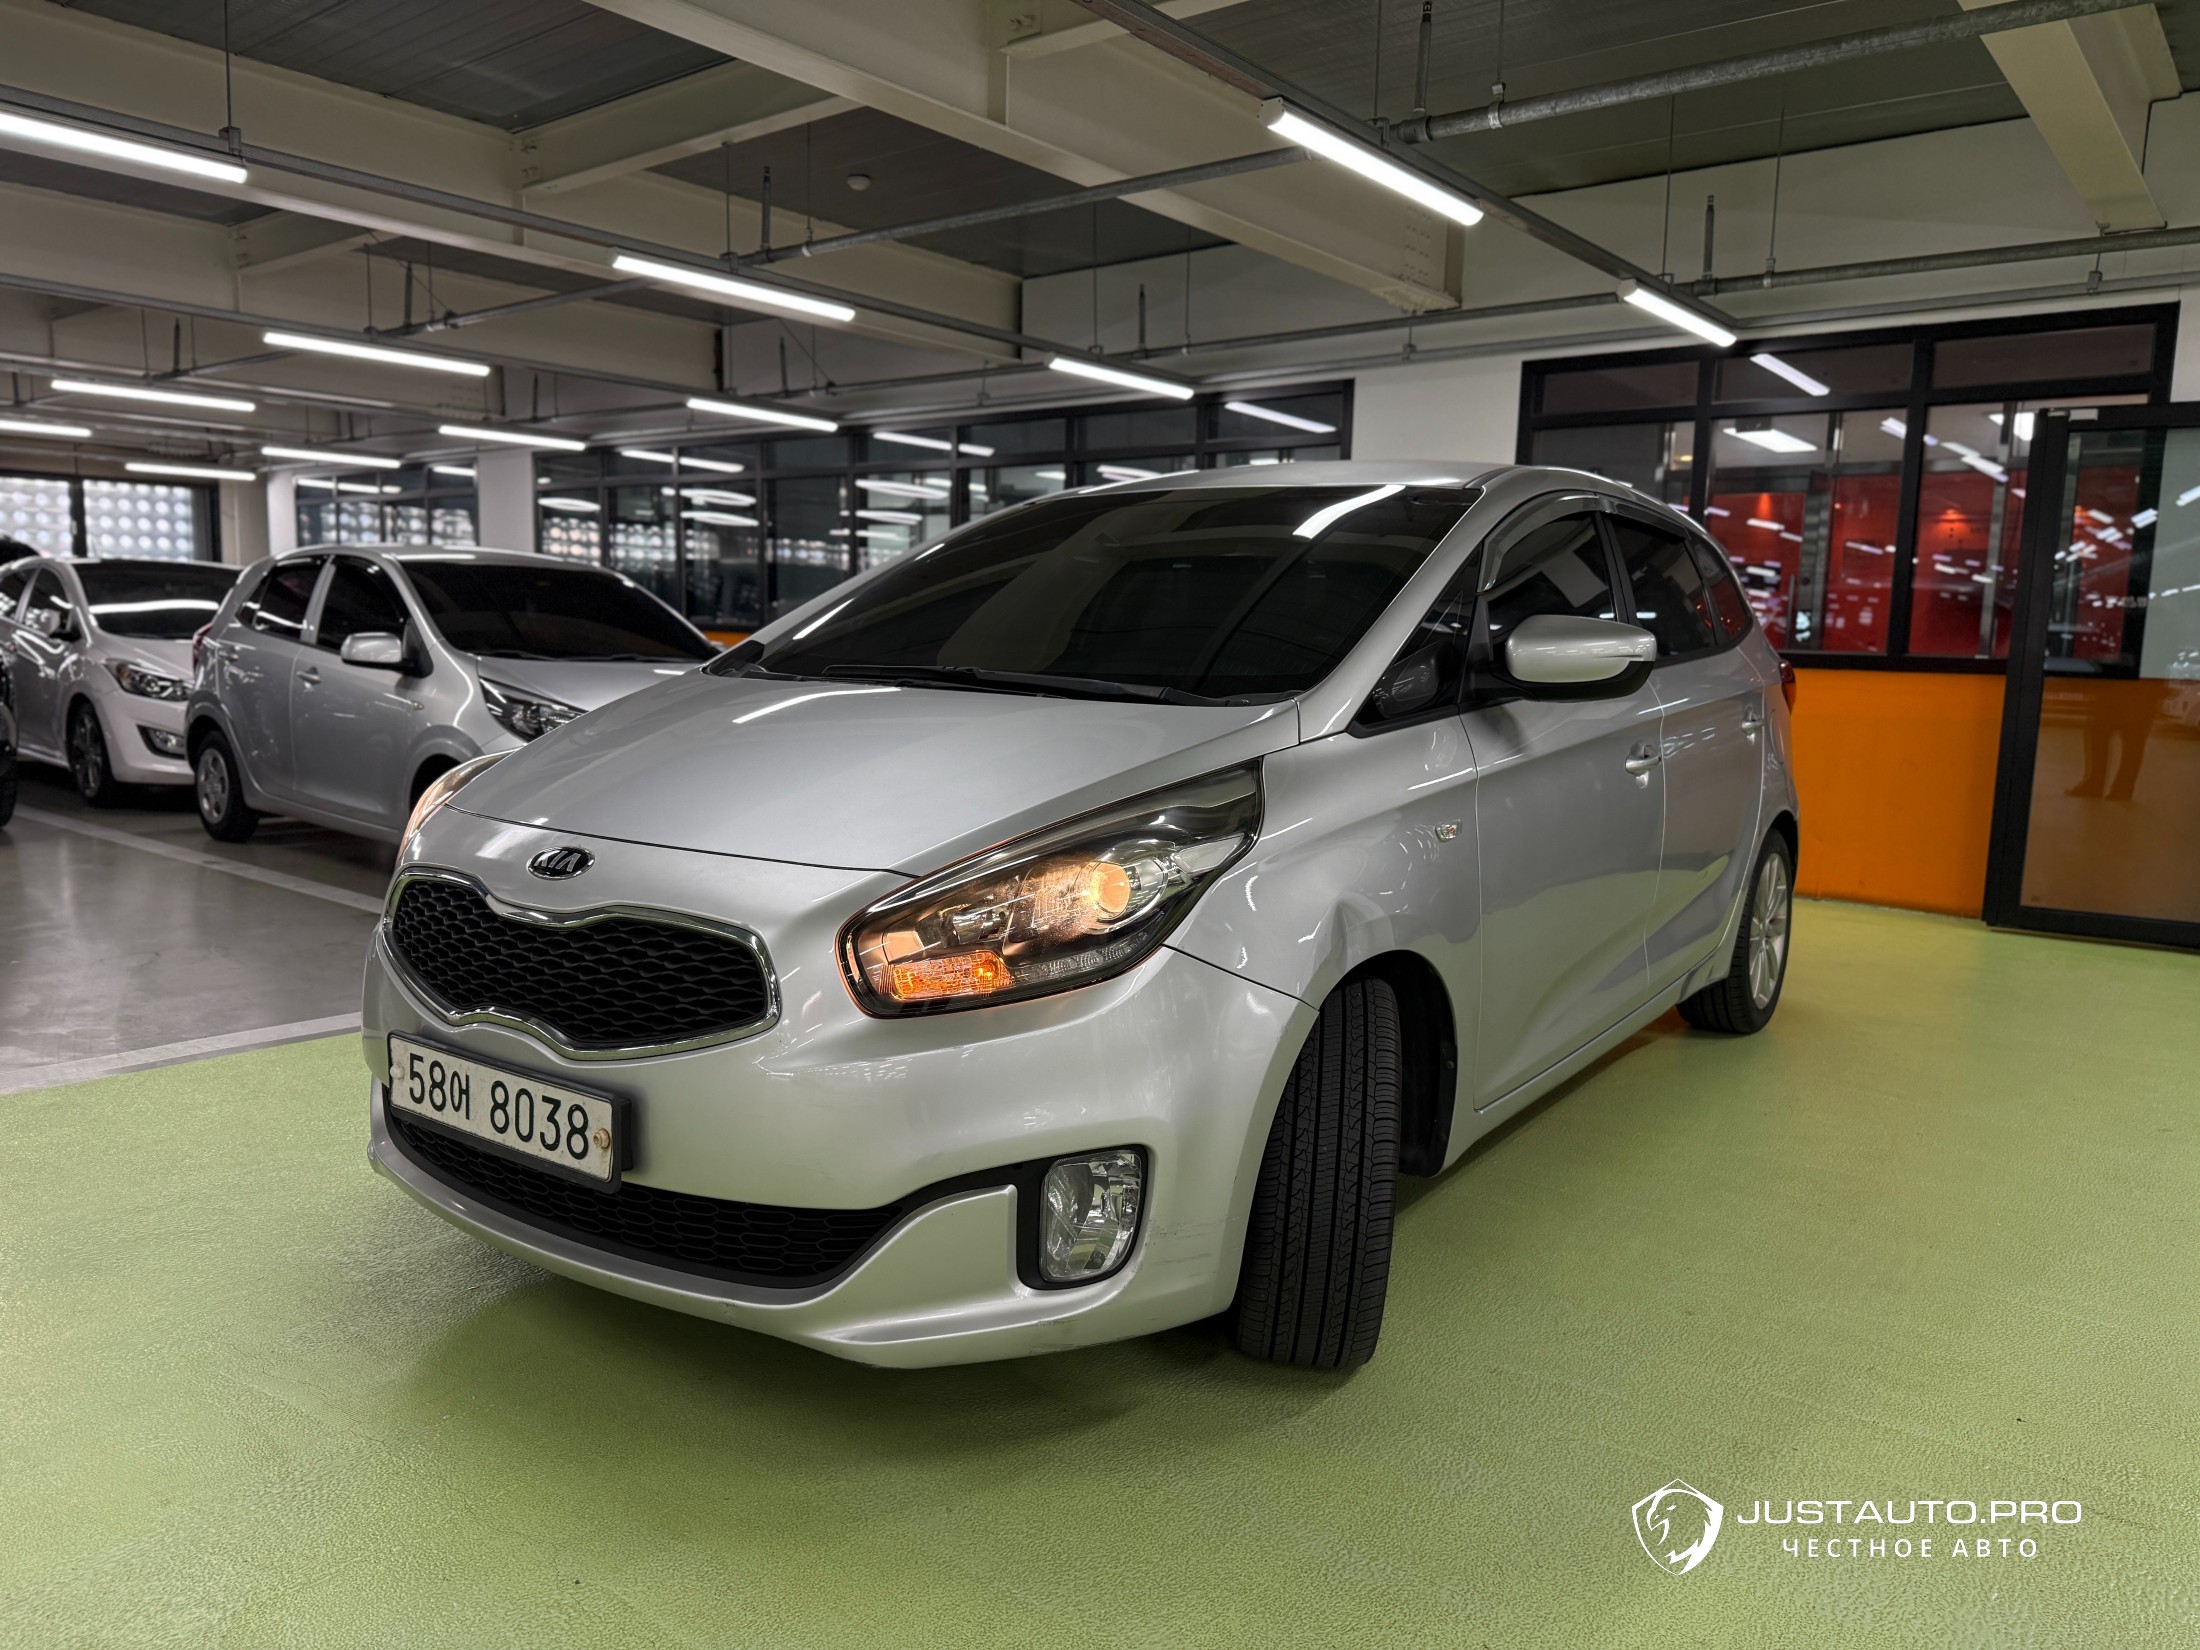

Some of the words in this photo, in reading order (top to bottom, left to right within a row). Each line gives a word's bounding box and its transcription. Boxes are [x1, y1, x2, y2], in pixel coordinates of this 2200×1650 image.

[533, 849, 582, 873] KIA
[409, 1052, 470, 1120] 58어
[489, 1080, 589, 1160] 8038
